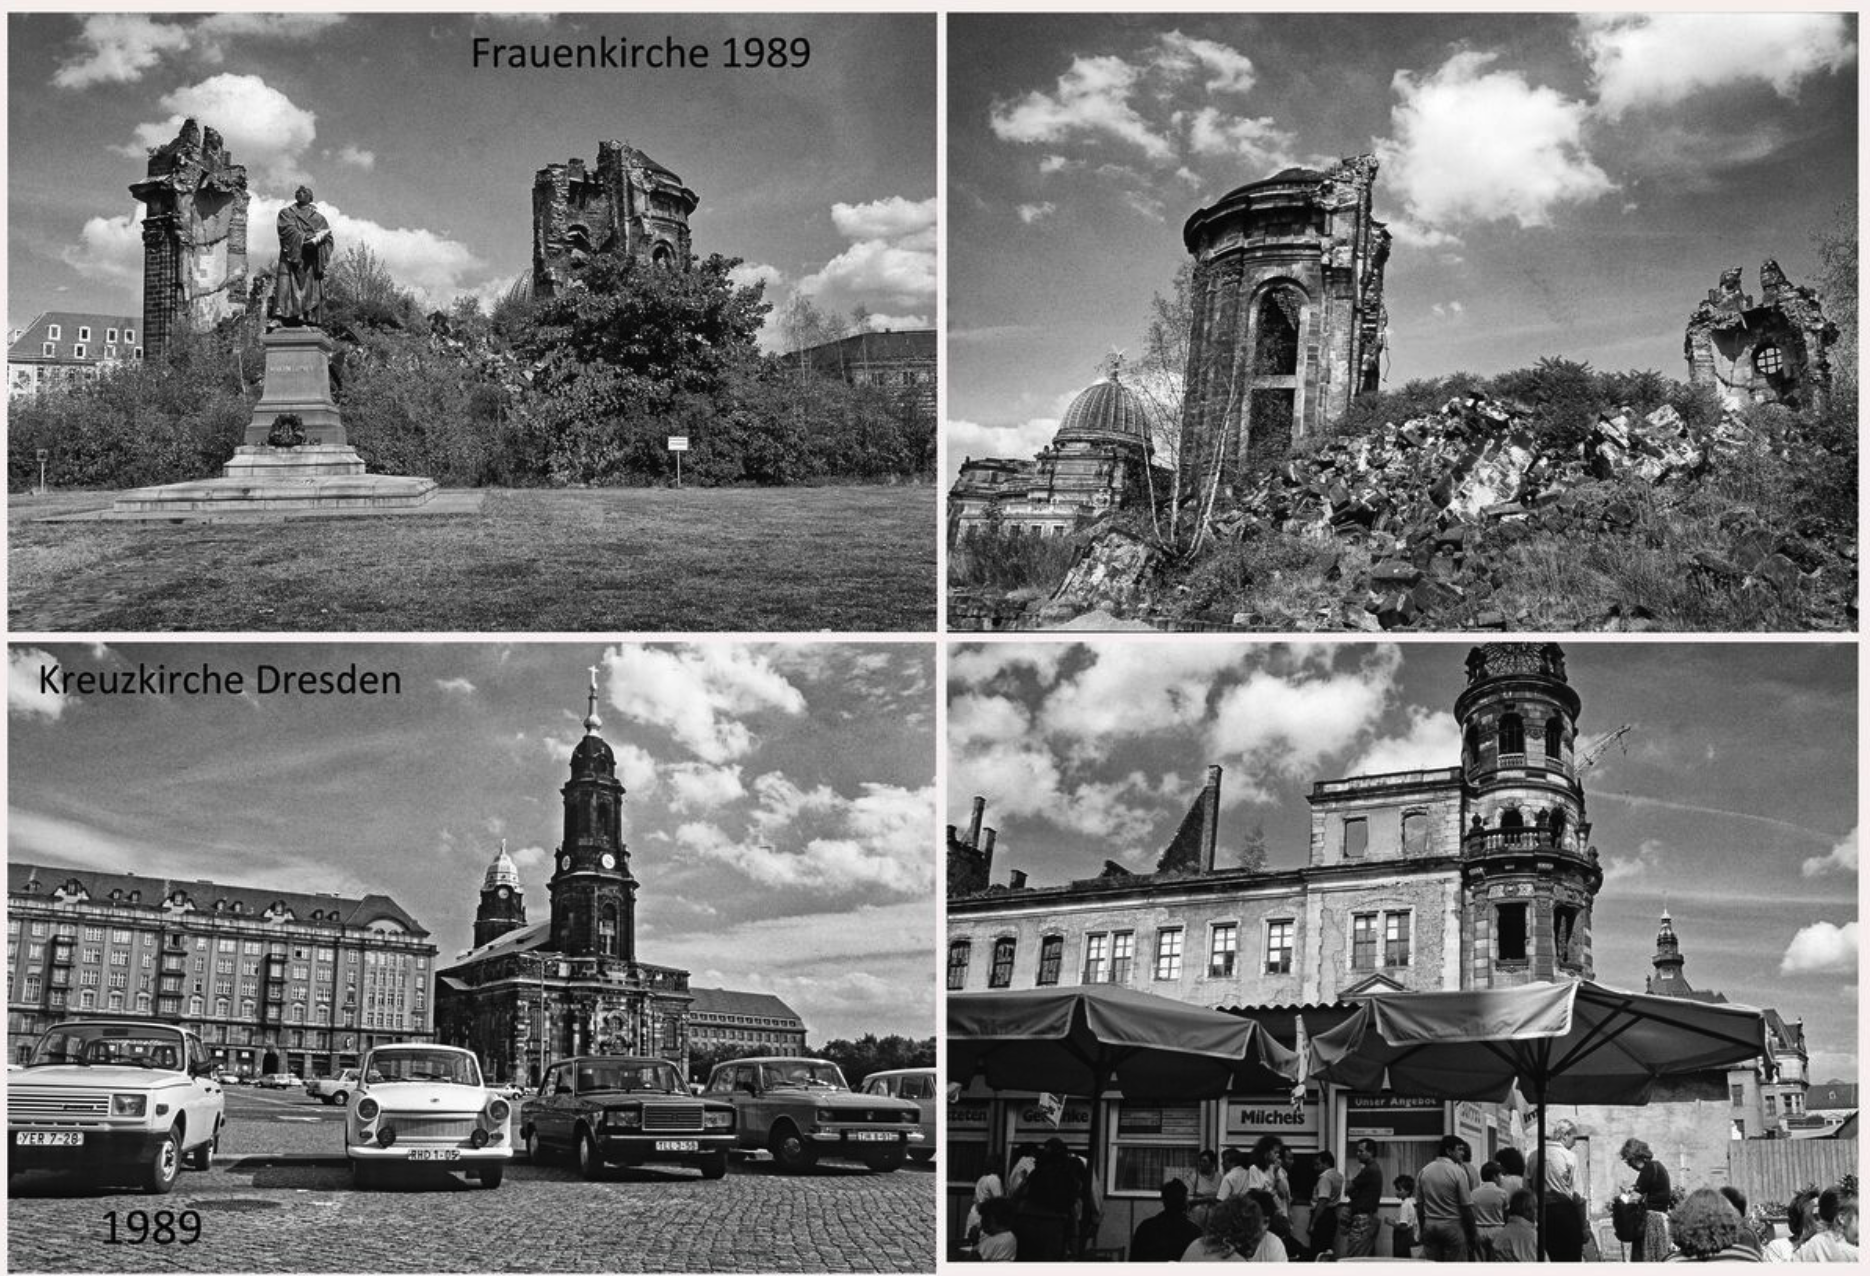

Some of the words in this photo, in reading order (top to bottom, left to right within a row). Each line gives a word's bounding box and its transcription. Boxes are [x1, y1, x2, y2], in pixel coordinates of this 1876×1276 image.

[1355, 1097, 1386, 1107] Unser
[1241, 1109, 1306, 1125] Milcheis
[21, 1132, 46, 1145] YER
[50, 1132, 80, 1145] 7-28
